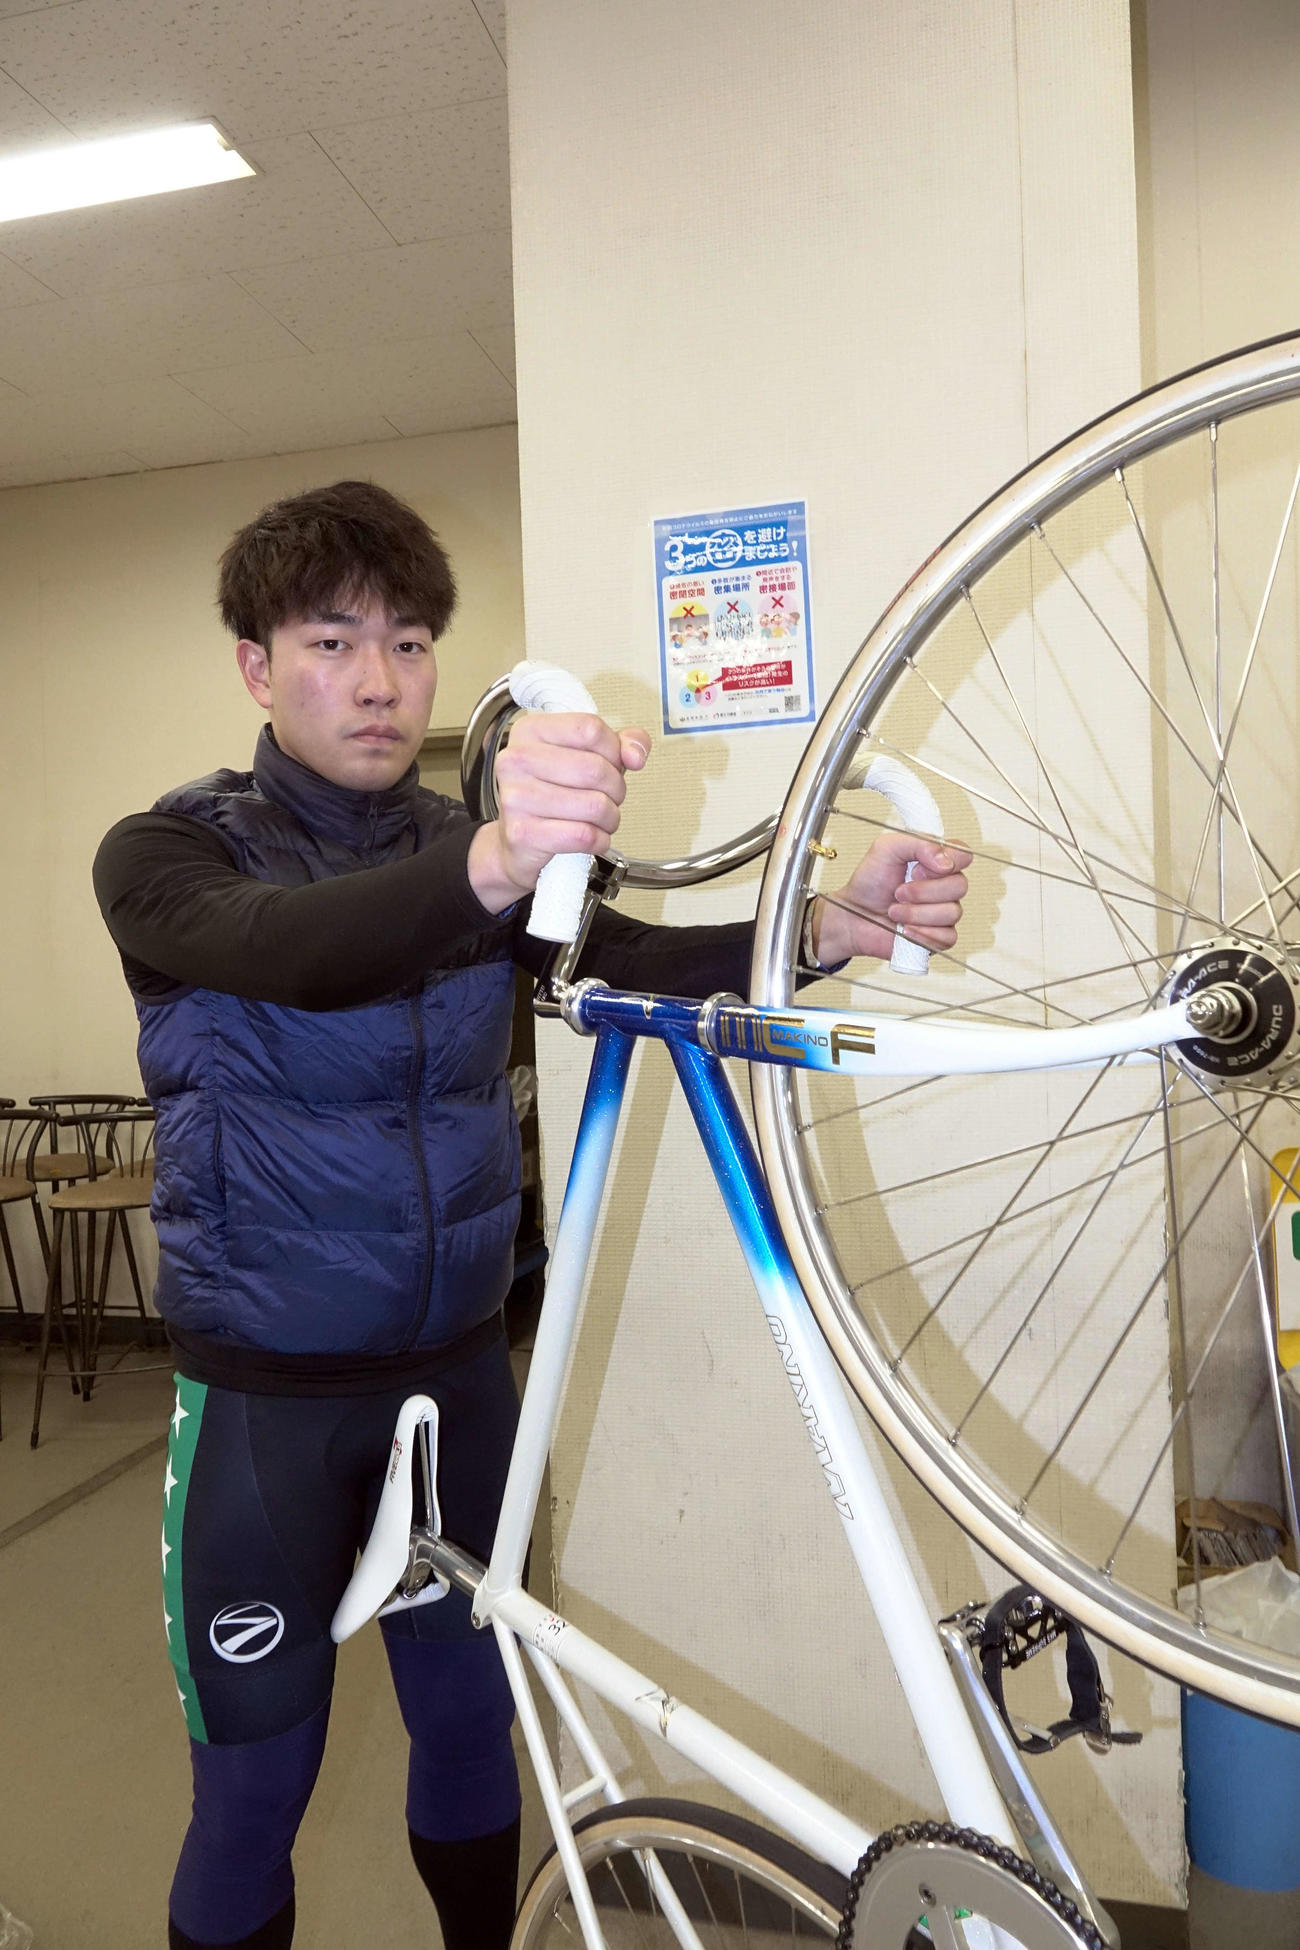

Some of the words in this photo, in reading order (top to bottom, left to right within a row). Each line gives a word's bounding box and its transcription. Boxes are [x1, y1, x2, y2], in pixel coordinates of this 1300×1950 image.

[744, 526, 786, 544] を避け
[714, 582, 750, 595] 密集場所
[759, 581, 796, 594] 密接場面
[685, 692, 692, 702] 2
[704, 691, 712, 701] 3
[773, 1029, 829, 1047] MAKINO
[1226, 1003, 1283, 1067] DURA-ACE
